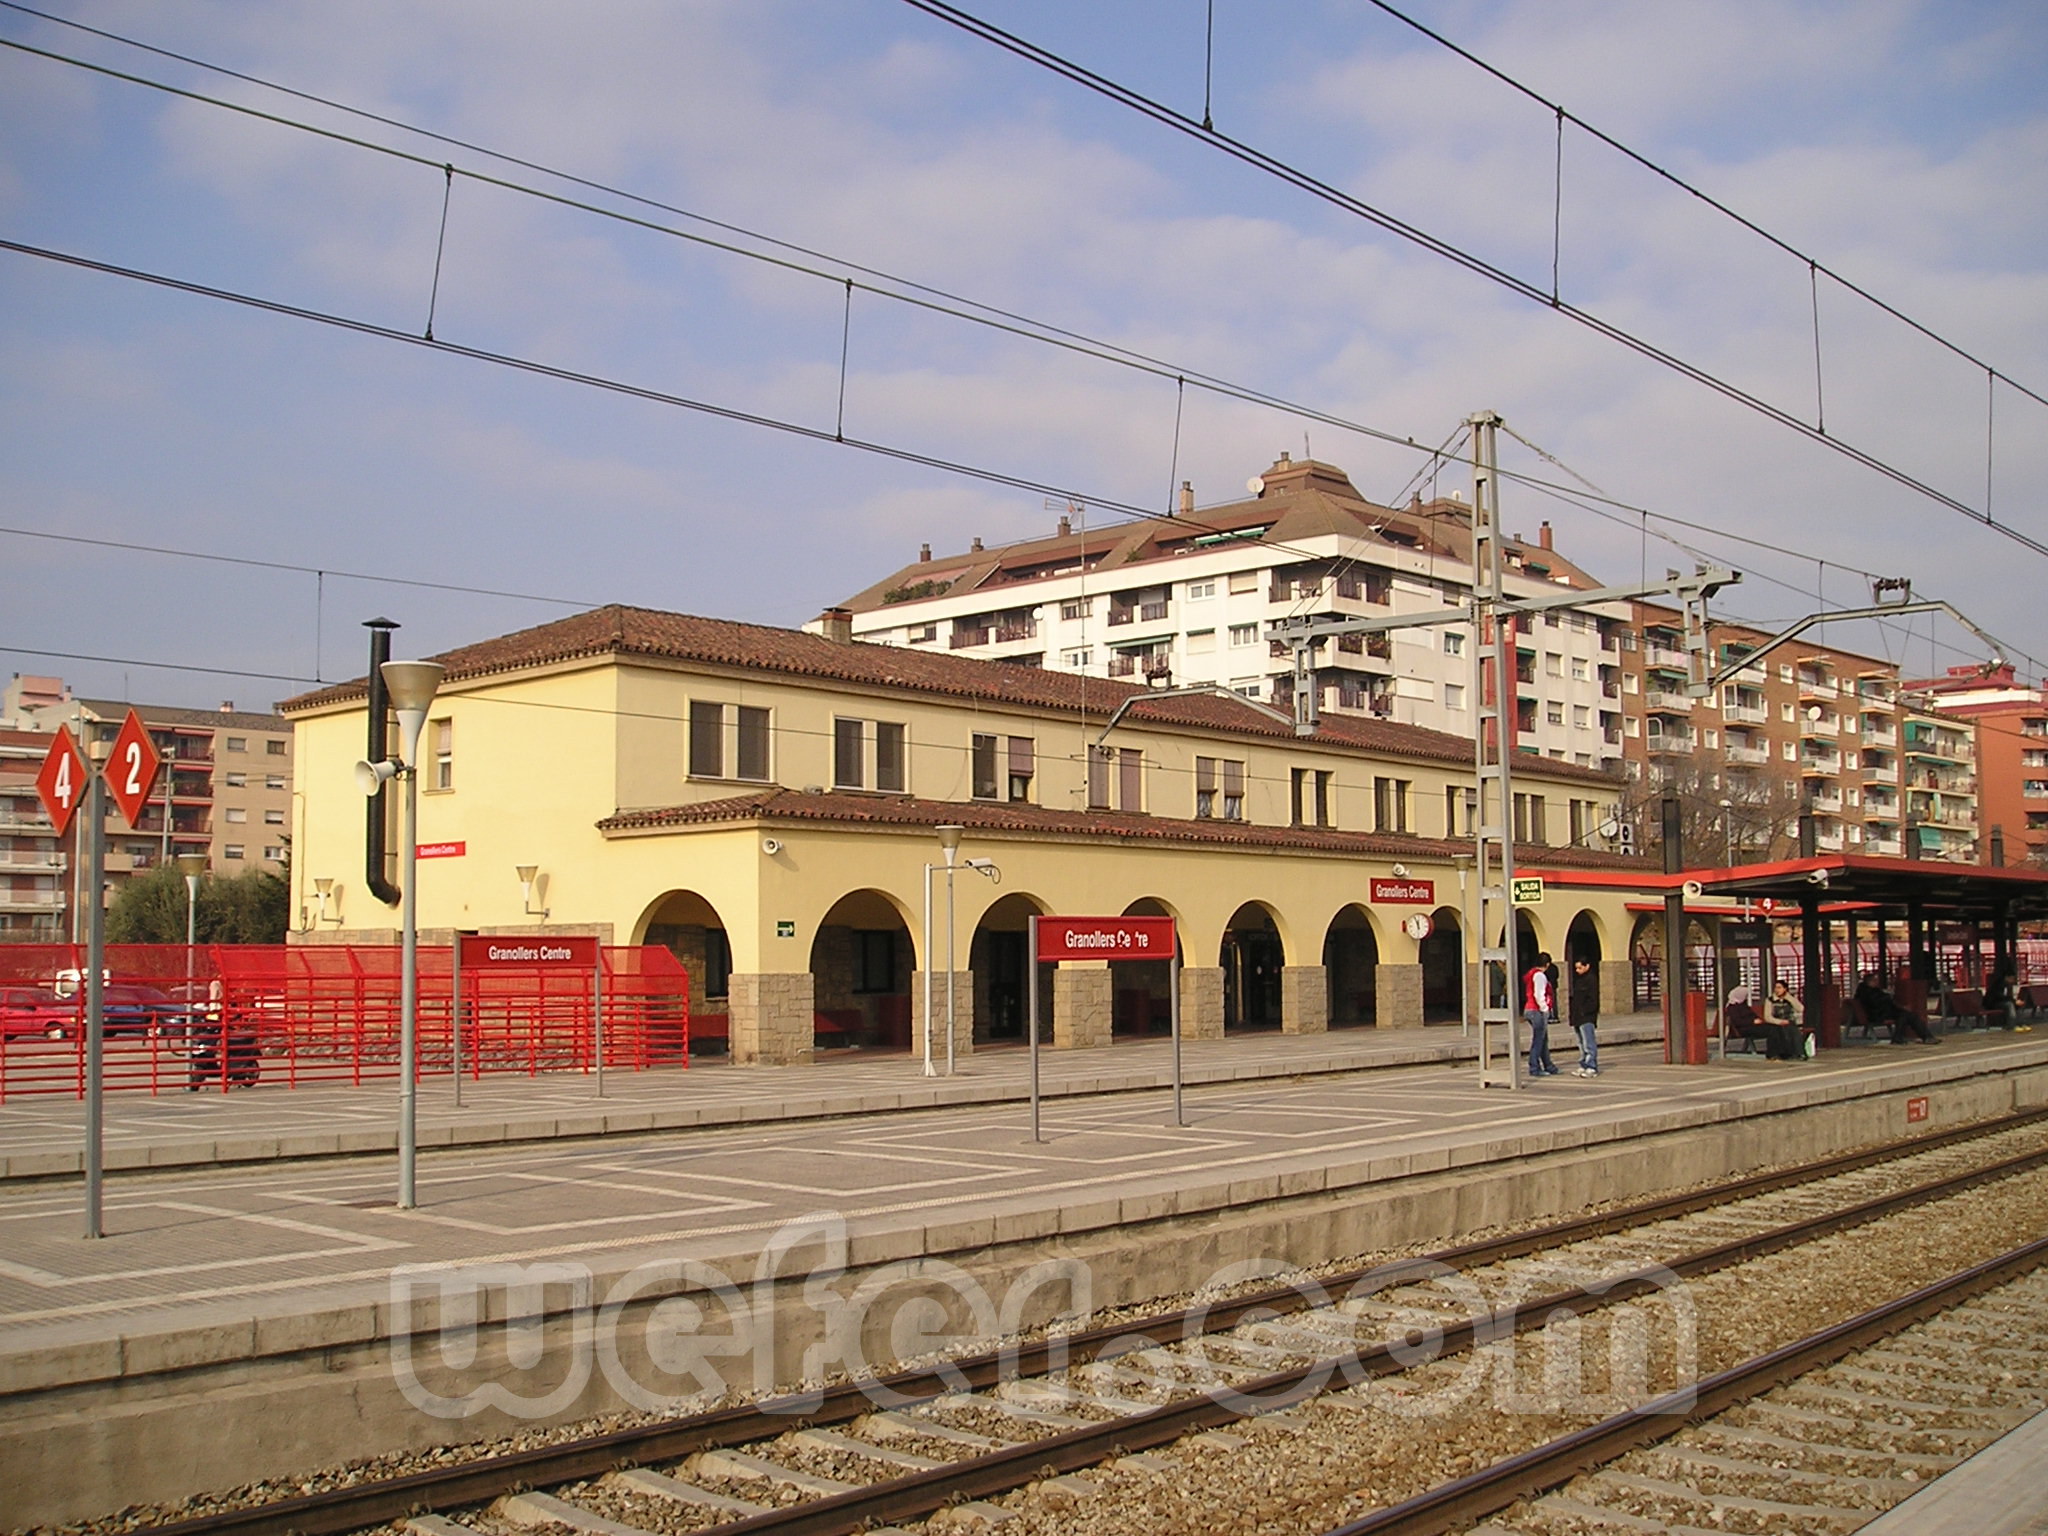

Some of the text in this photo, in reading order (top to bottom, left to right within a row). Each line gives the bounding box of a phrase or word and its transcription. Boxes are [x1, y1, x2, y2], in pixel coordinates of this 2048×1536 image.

[125, 742, 140, 794] 2
[54, 752, 71, 809] 4
[1376, 884, 1429, 898] Granollers Centre
[1763, 898, 1772, 910] 4
[1065, 930, 1148, 948] Granollers Cere
[488, 946, 572, 960] Granollers Centre
